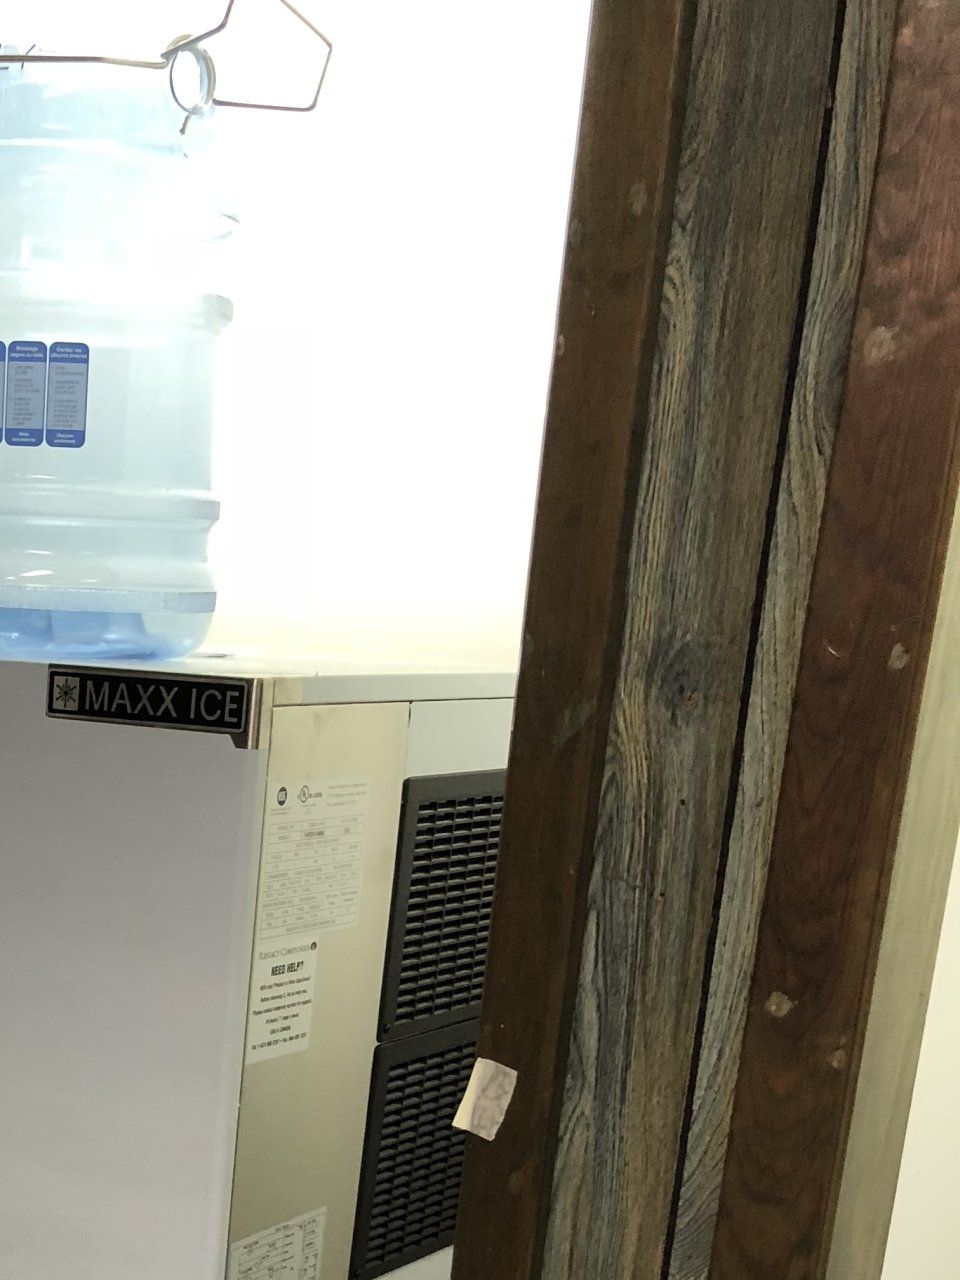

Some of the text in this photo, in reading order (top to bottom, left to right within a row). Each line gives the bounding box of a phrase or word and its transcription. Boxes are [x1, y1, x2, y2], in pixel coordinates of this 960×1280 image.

[85, 680, 240, 723] MAXX ICE
[271, 960, 304, 976] NEED HELP?
